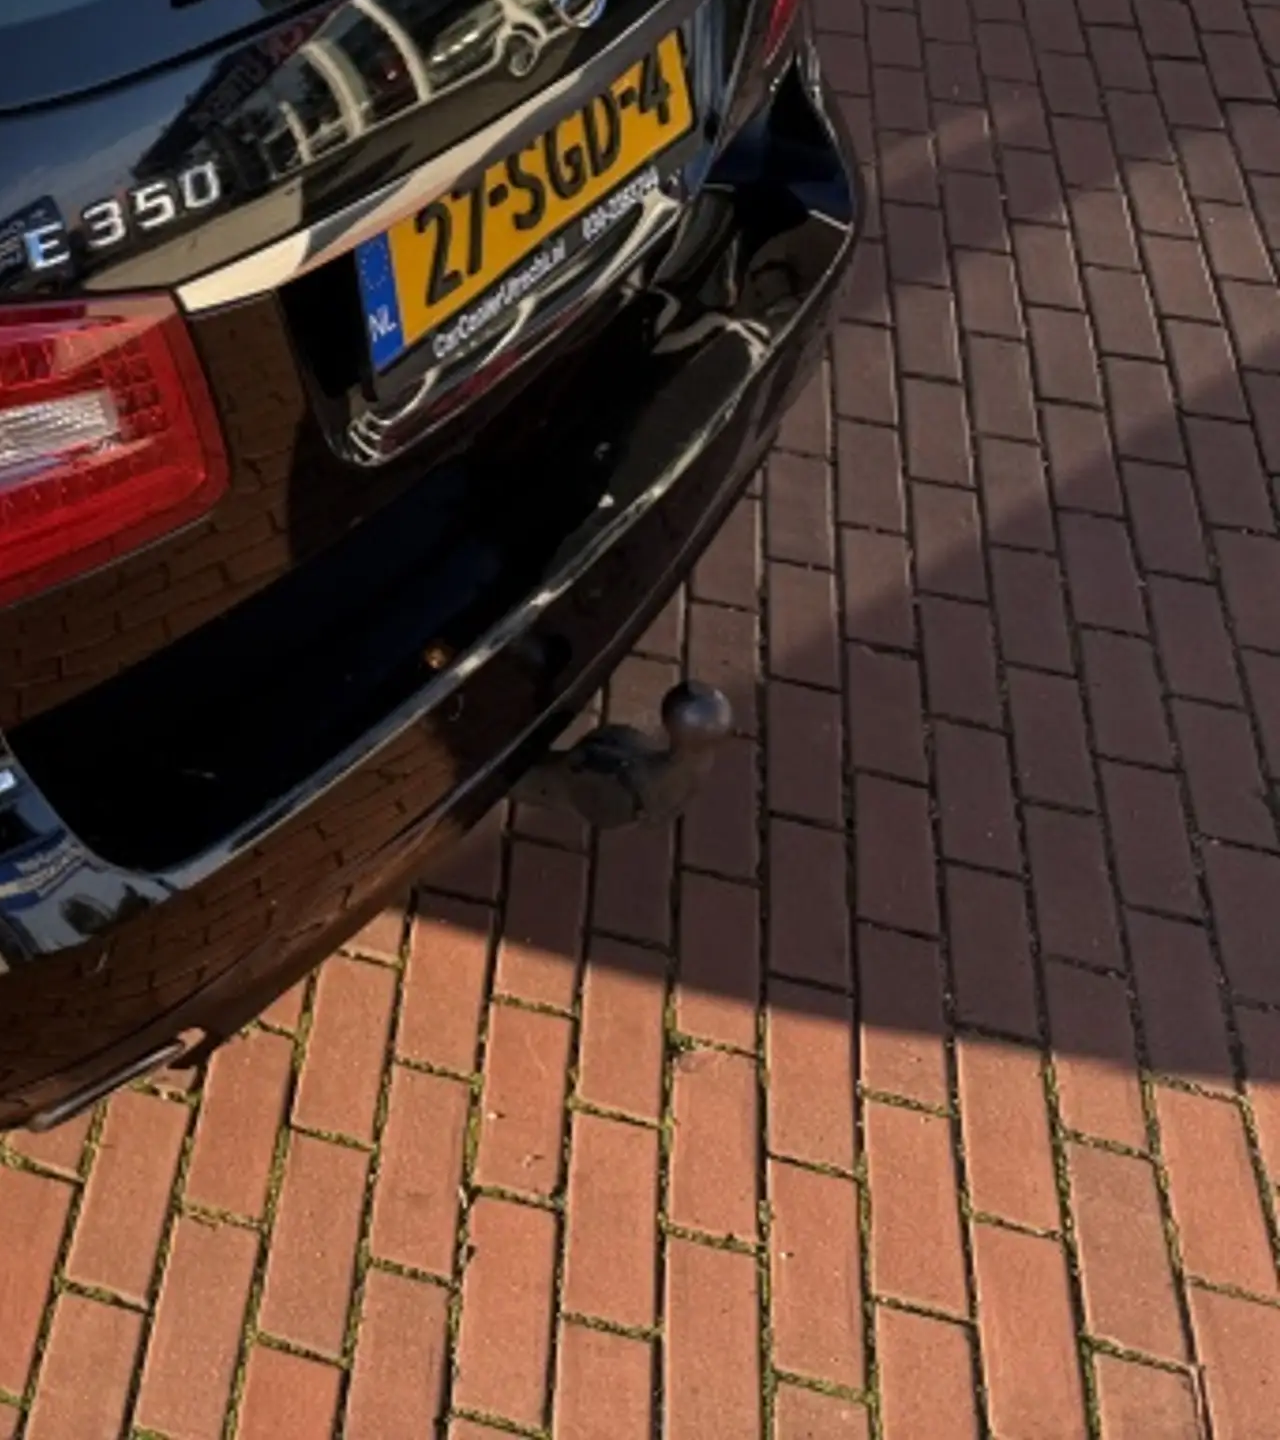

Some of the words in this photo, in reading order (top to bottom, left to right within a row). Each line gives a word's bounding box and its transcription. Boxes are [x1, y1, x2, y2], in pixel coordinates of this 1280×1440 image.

[23, 220, 71, 272] E
[83, 161, 221, 248] 350
[414, 51, 672, 308] 27-SGD-4
[367, 303, 396, 343] NL
